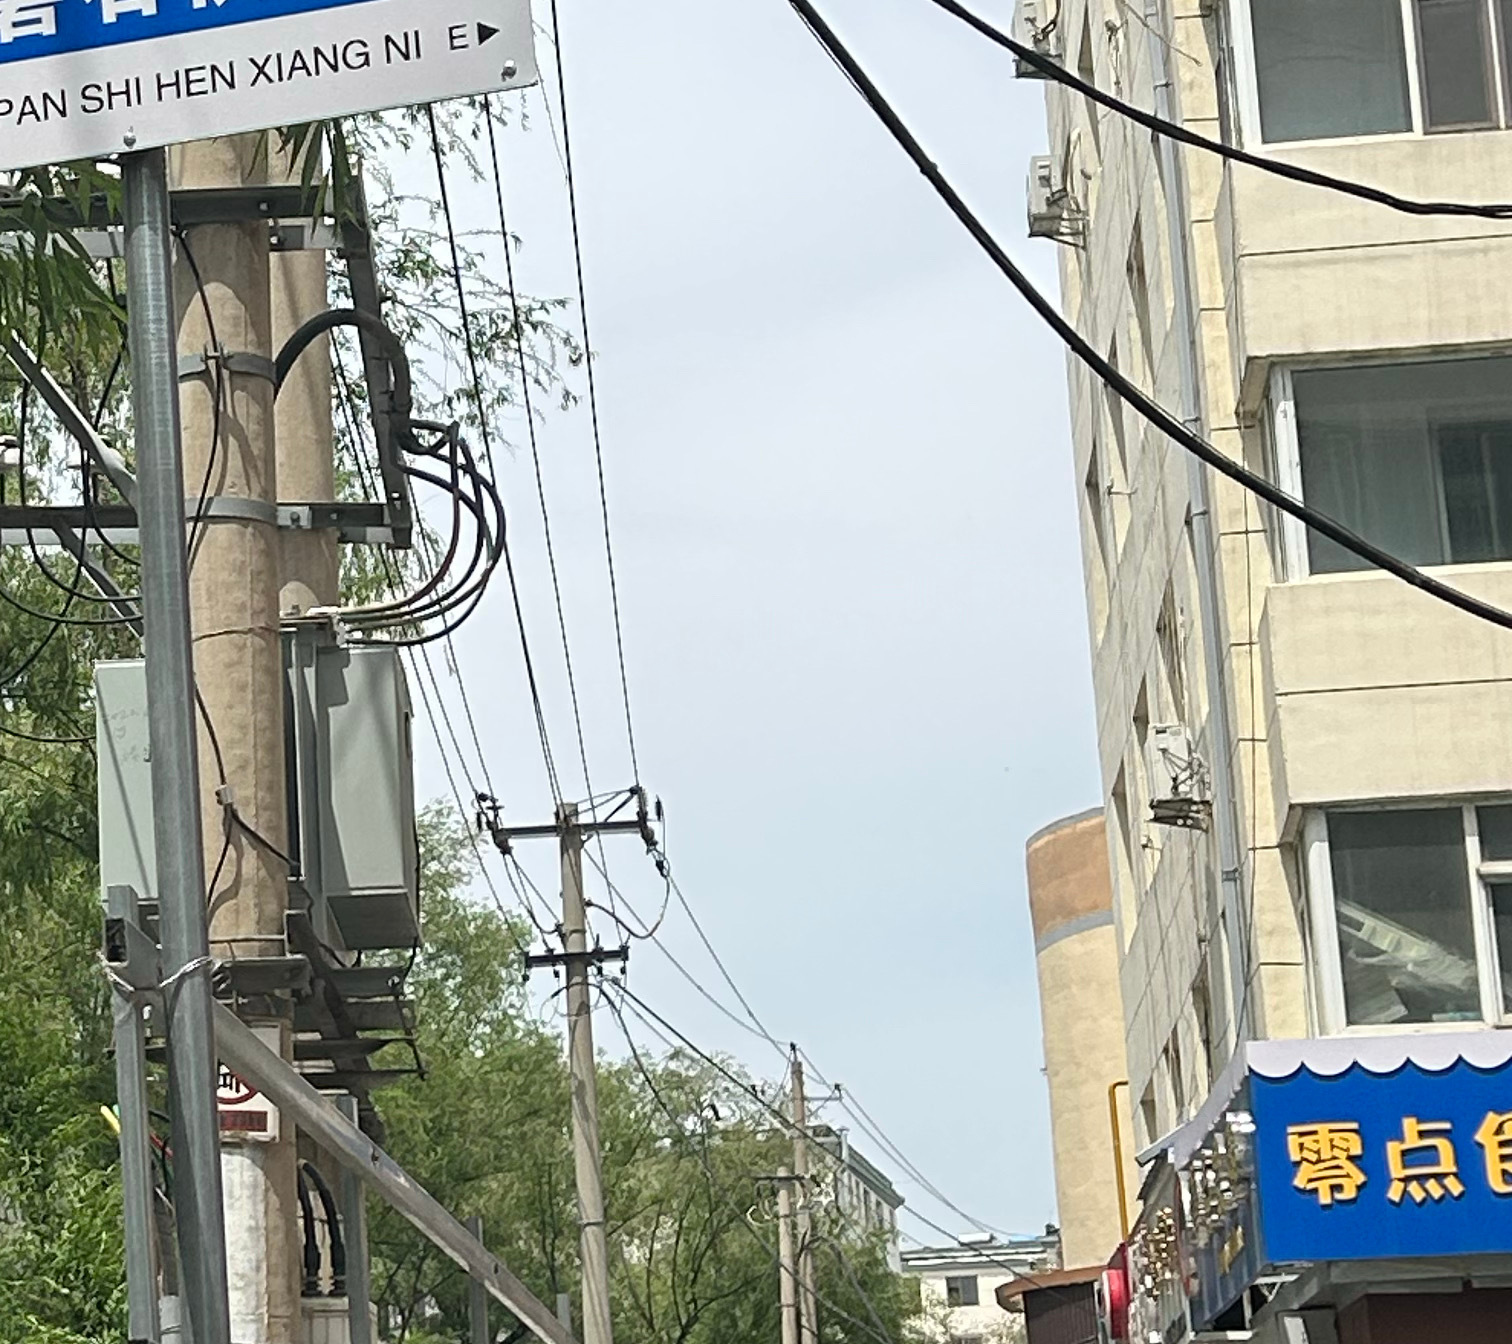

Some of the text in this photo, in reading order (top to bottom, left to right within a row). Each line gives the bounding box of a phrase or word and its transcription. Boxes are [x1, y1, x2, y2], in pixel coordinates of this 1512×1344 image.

[79, 77, 142, 114] SHI
[155, 60, 236, 102] HEN
[249, 39, 371, 88] XIANG
[384, 29, 422, 64] NI
[447, 23, 469, 51] E
